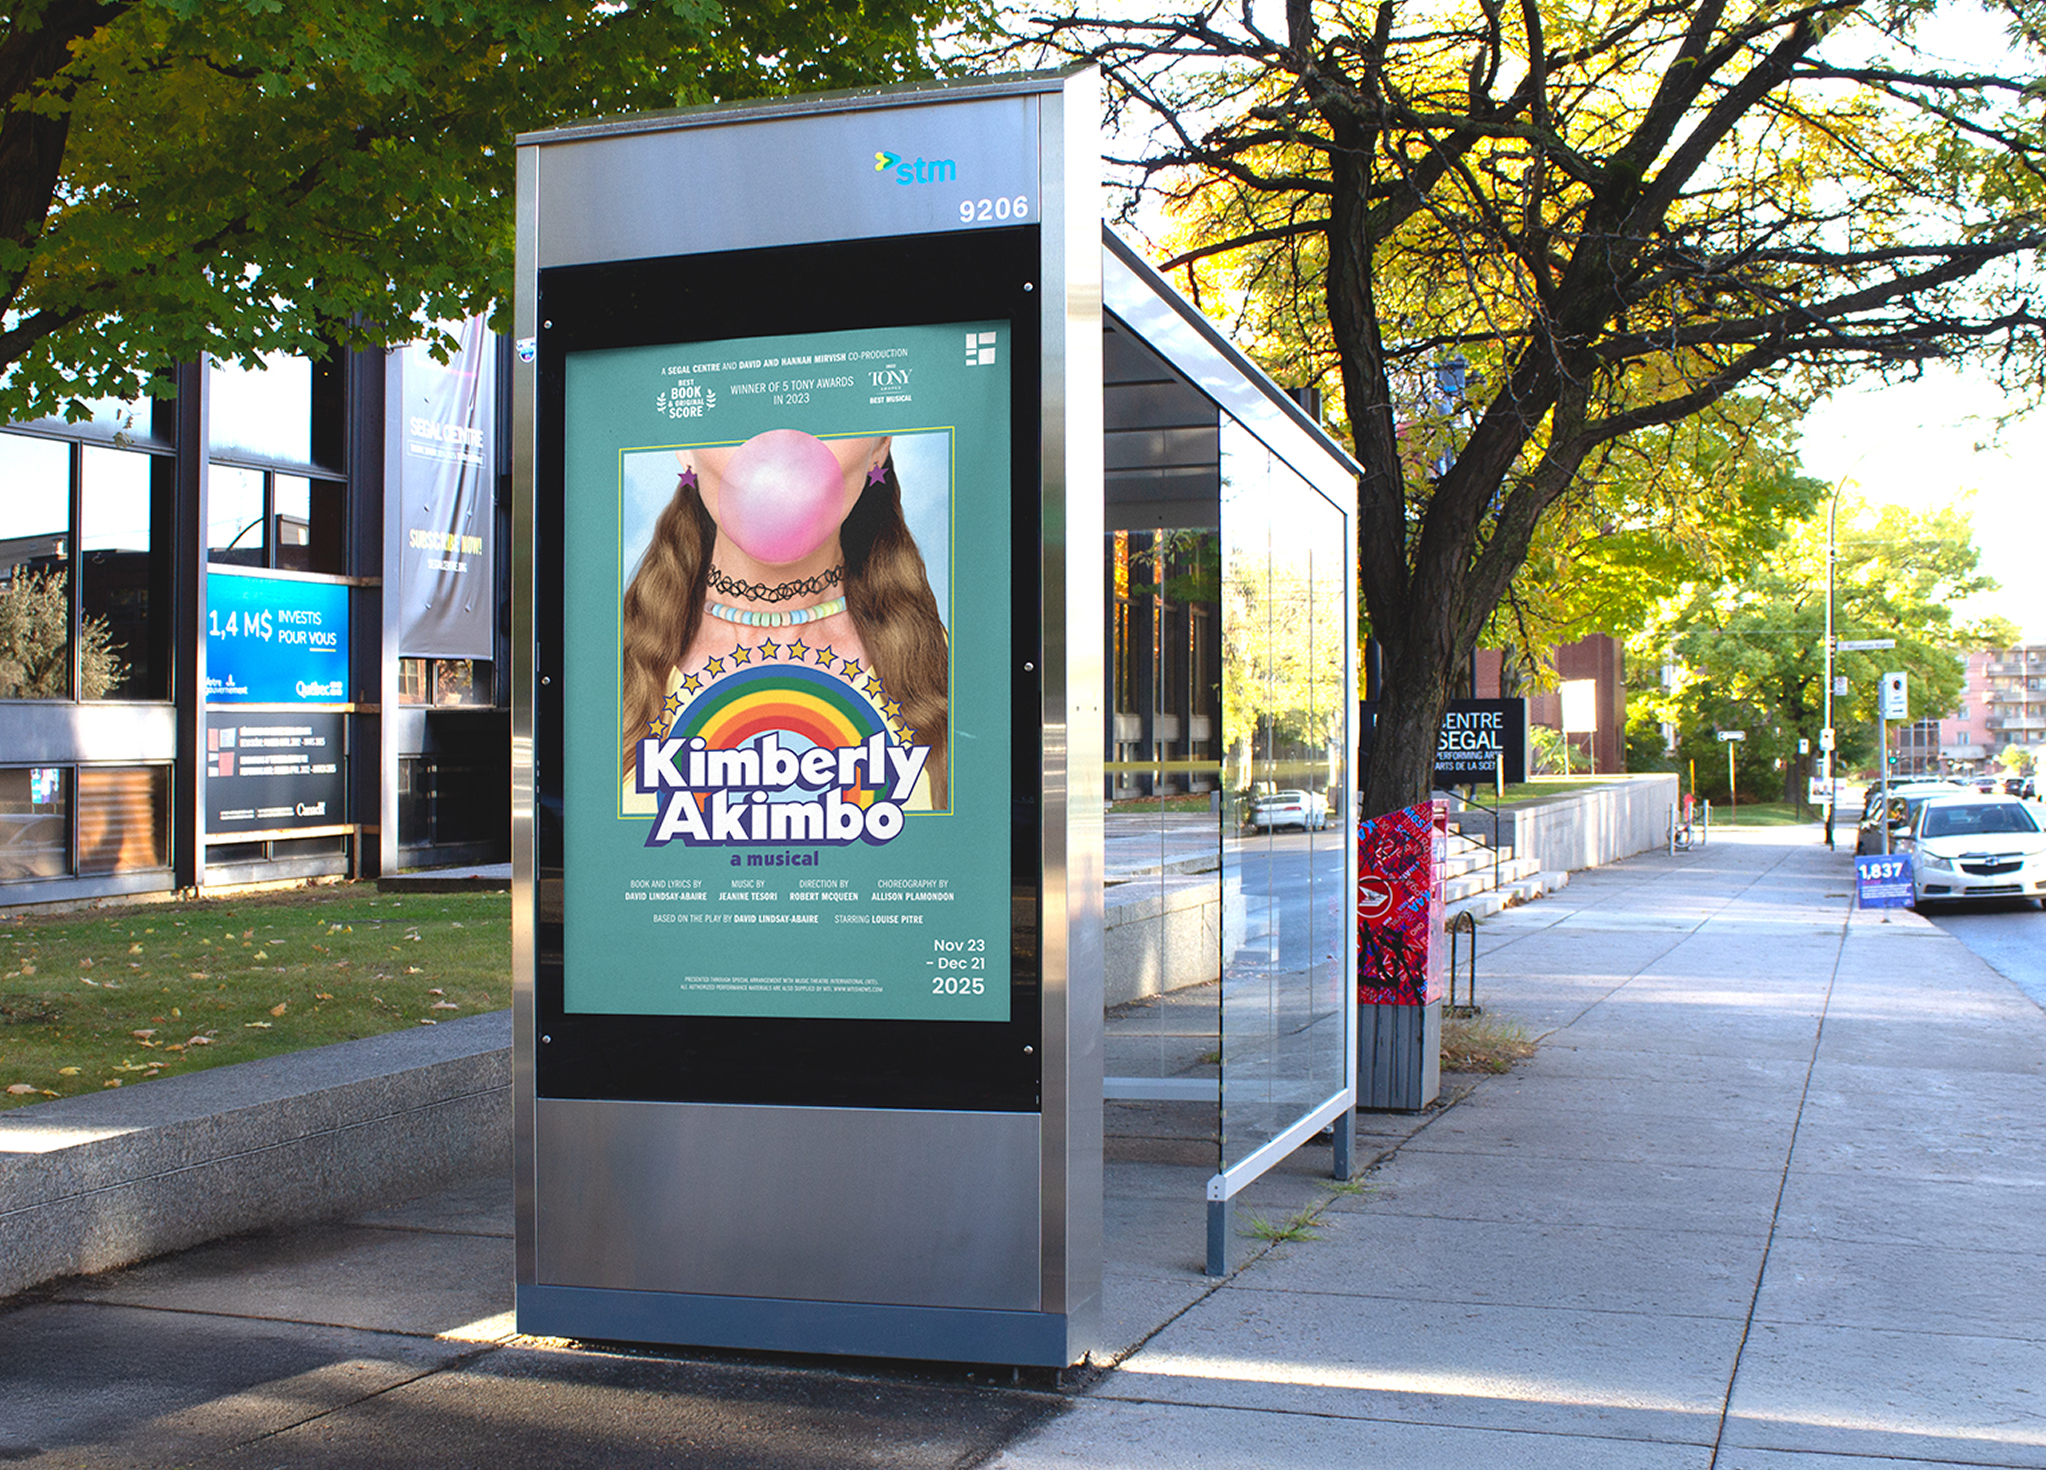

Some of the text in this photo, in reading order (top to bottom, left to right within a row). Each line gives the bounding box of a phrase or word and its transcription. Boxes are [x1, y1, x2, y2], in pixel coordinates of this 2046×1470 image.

[896, 157, 956, 186] stm
[959, 195, 1029, 223] 9206
[661, 348, 908, 376] A SEGAL CENTRE AND DAVID AND HANNAH MIRVISH CO-PRODUCTION
[678, 379, 694, 387] BEST
[868, 368, 913, 386] TONY
[730, 376, 854, 395] WINNER OF 5 TONY AWARDS
[671, 386, 702, 400] BOOK
[773, 393, 810, 405] IN 2023
[869, 395, 912, 404] BEST MUSICAL
[675, 398, 705, 407] ORIGINAL
[669, 406, 703, 419] SCORE
[410, 416, 484, 449] SEGAL CENTRE
[409, 528, 482, 556] SUBSCRIBE NOW!
[209, 609, 322, 642] 1,4 M$ INVESTIS
[278, 630, 337, 646] POUR VOUS
[1442, 712, 1503, 729] ENTRE
[1438, 731, 1503, 750] SEGAL
[637, 730, 932, 804] Kimberly
[1435, 761, 1454, 771] ARTS
[1455, 761, 1466, 771] DE
[1467, 761, 1478, 771] LA
[645, 787, 905, 847] Akimbo
[730, 851, 819, 867] a musical
[1859, 862, 1903, 880] 1,837
[630, 879, 703, 889] BOOK AND LYRICS BY
[731, 879, 766, 889] MUSIC BY
[799, 879, 849, 889] DIRECTION BY
[877, 879, 949, 889] CHOREOGRAPHY BY
[625, 892, 707, 901] DAVID LINDSAY-ABAIRE
[718, 892, 778, 901] JEANINE TESORI
[789, 892, 859, 902] ROBERT MCQUEEN
[871, 892, 955, 901] ALLISON PLAMONDON
[653, 914, 819, 924] BASED ON THE PLAY BY DAVID LINDSAY-ABAIRE
[834, 914, 924, 924] STARRING LOUISE PITRE
[934, 939, 985, 952] Nov 23
[938, 957, 967, 970] Dec
[971, 957, 985, 970] 21
[932, 977, 985, 995] 2025
